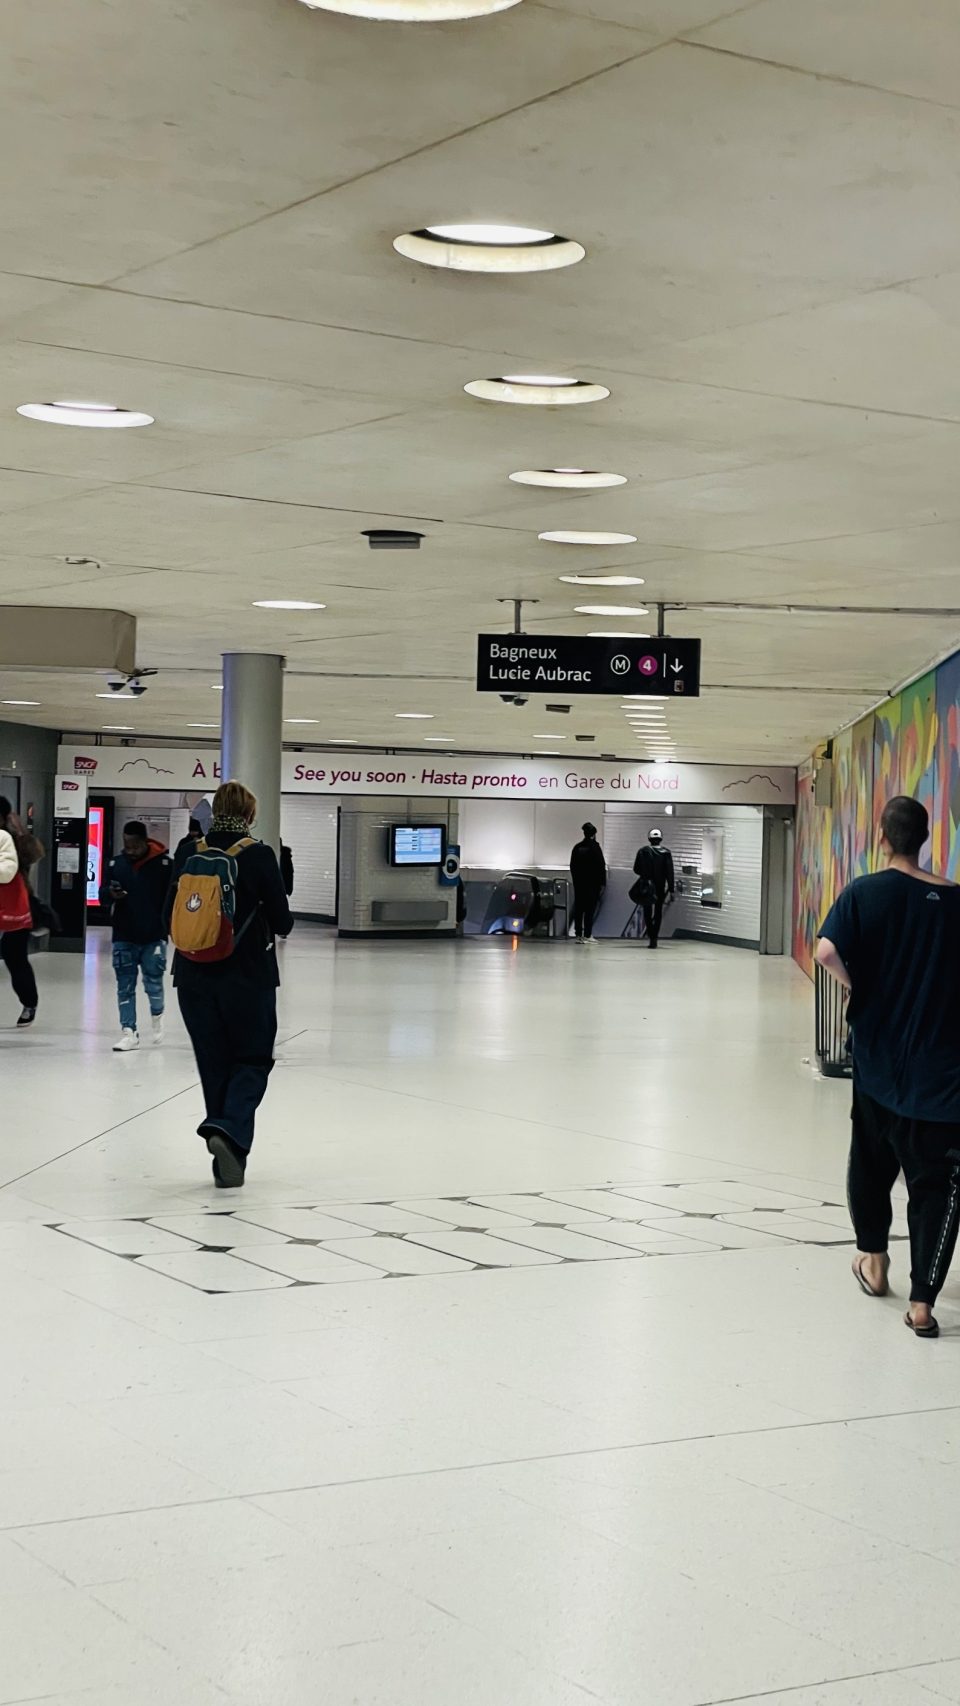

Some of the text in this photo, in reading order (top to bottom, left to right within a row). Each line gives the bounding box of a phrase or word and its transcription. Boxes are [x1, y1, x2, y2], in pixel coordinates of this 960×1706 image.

[489, 643, 557, 663] Bagneux
[489, 665, 592, 682] Lucie Aubrac
[642, 660, 652, 671] 4
[75, 761, 97, 769] SNCF
[191, 758, 206, 778] À
[293, 764, 527, 789] See you soon Hasta pronto
[538, 773, 680, 790] en Gare du Nord
